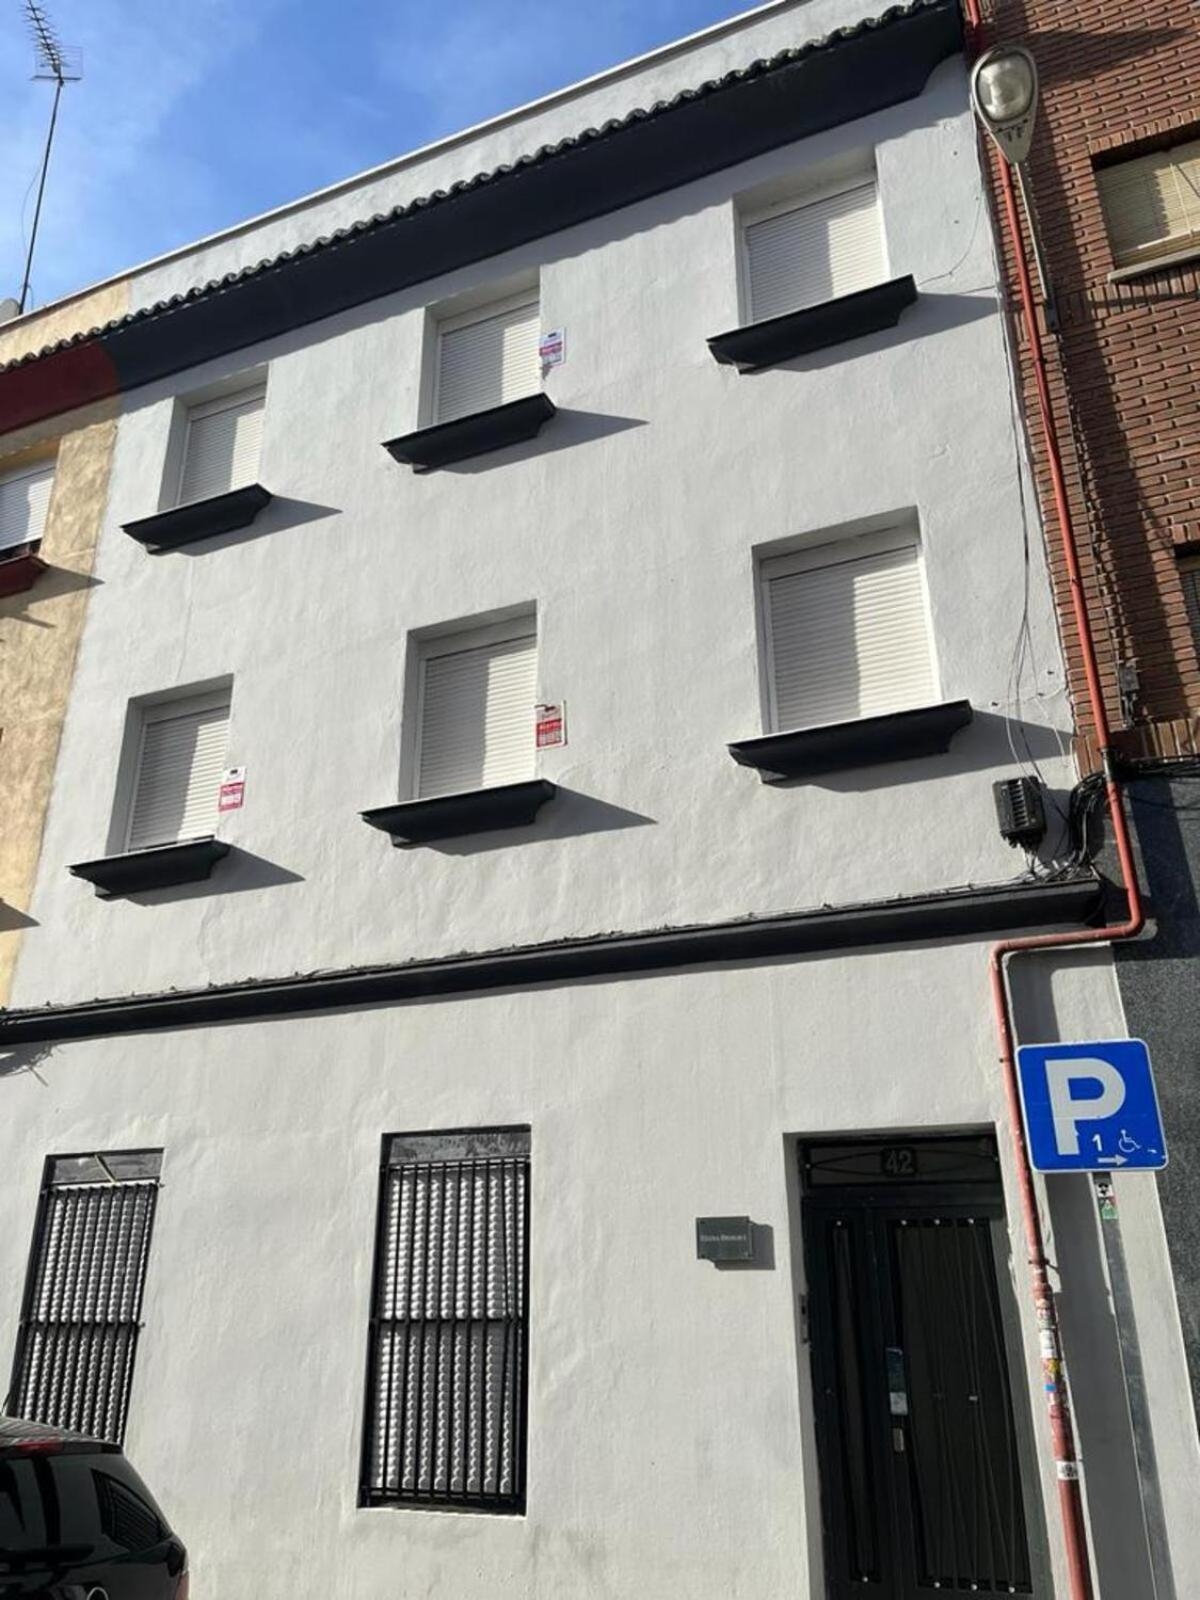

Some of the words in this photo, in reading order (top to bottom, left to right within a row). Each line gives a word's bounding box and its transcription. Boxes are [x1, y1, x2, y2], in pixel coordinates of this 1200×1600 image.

[1045, 1058, 1126, 1155] P
[1092, 1133, 1103, 1153] 1
[885, 1149, 915, 1174] 42
